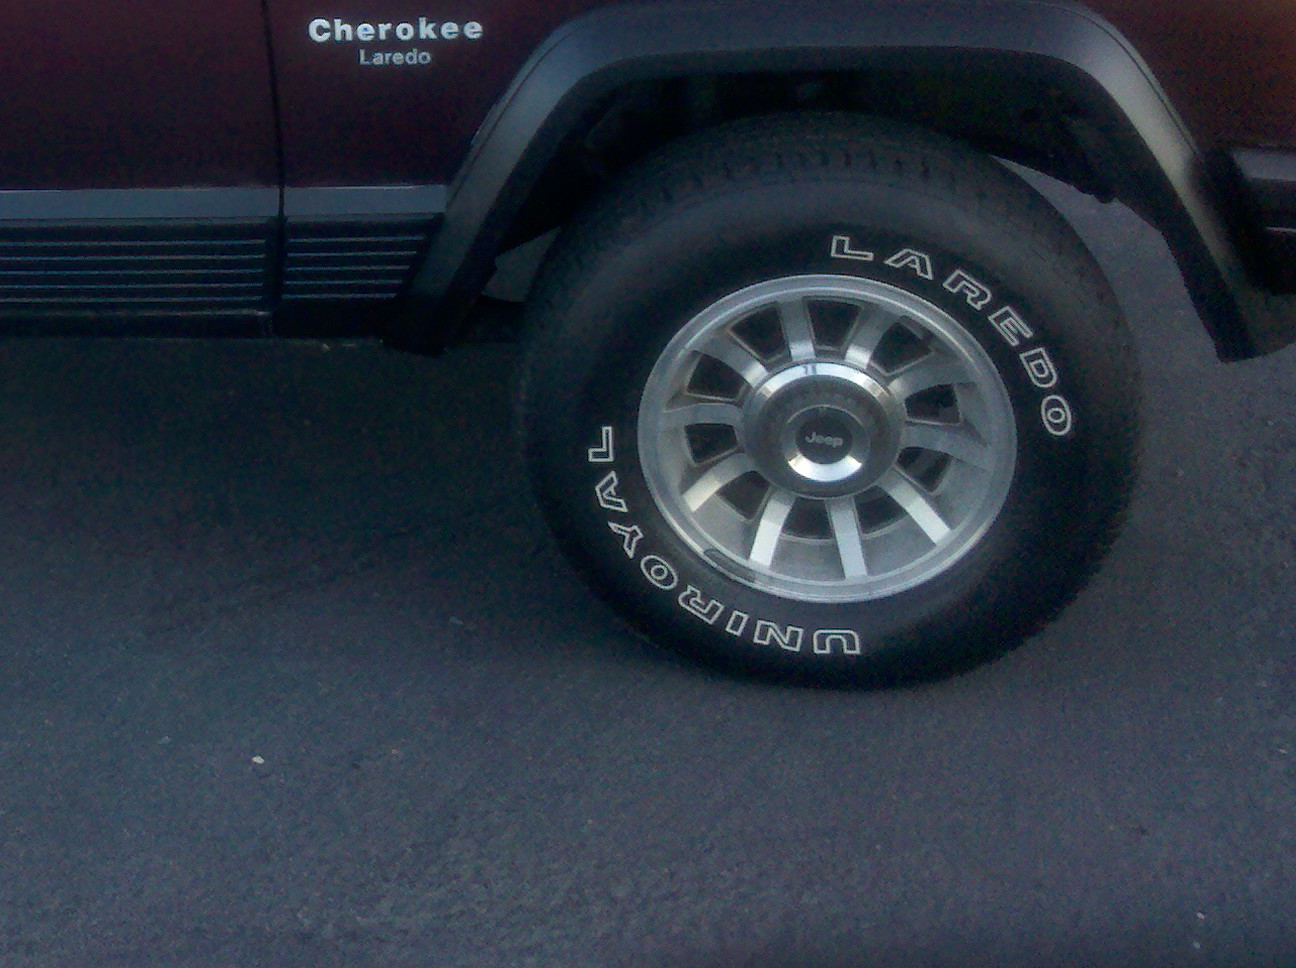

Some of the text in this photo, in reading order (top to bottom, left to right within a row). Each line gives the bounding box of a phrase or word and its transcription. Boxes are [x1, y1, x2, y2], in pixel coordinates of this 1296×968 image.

[308, 16, 484, 43] Cherokee
[359, 48, 432, 66] Laredo
[830, 235, 1073, 436] LAREDO
[804, 431, 844, 449] Jeep
[588, 426, 861, 656] UNIROYAL
